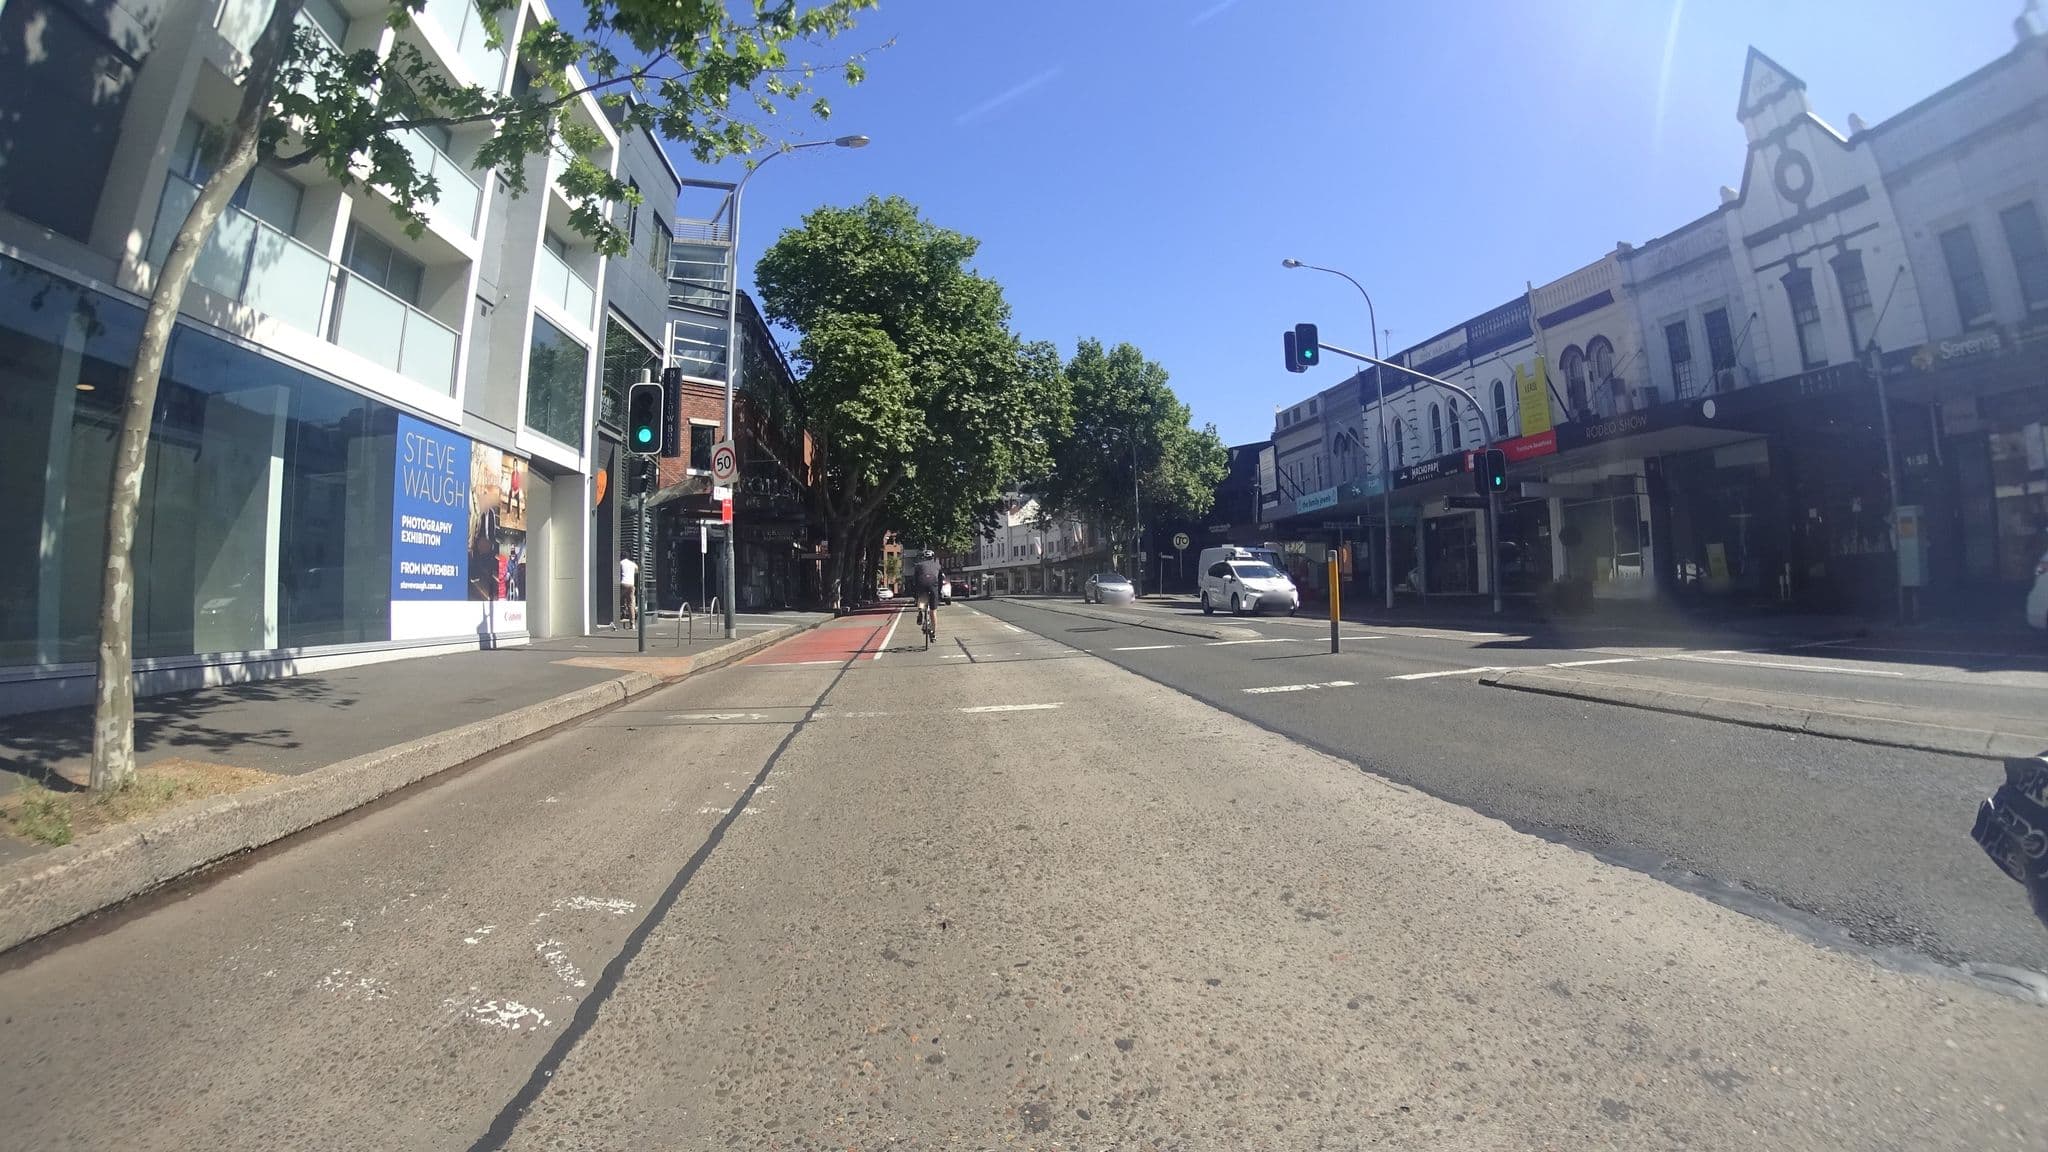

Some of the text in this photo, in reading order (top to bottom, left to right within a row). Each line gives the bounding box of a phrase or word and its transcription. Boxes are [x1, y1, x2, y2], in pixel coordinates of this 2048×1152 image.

[1525, 383, 1538, 393] LEASE
[1585, 415, 1648, 441] RODEO SHOW
[404, 432, 455, 475] STEVE
[717, 455, 731, 471] 50
[403, 465, 465, 509] WAUGH
[402, 515, 453, 534] PHOTOGRAPHY
[402, 530, 441, 546] EXHIBITION
[400, 562, 459, 577] FROM NOVEMBER 1
[400, 581, 443, 592] stevewaugh.com.au
